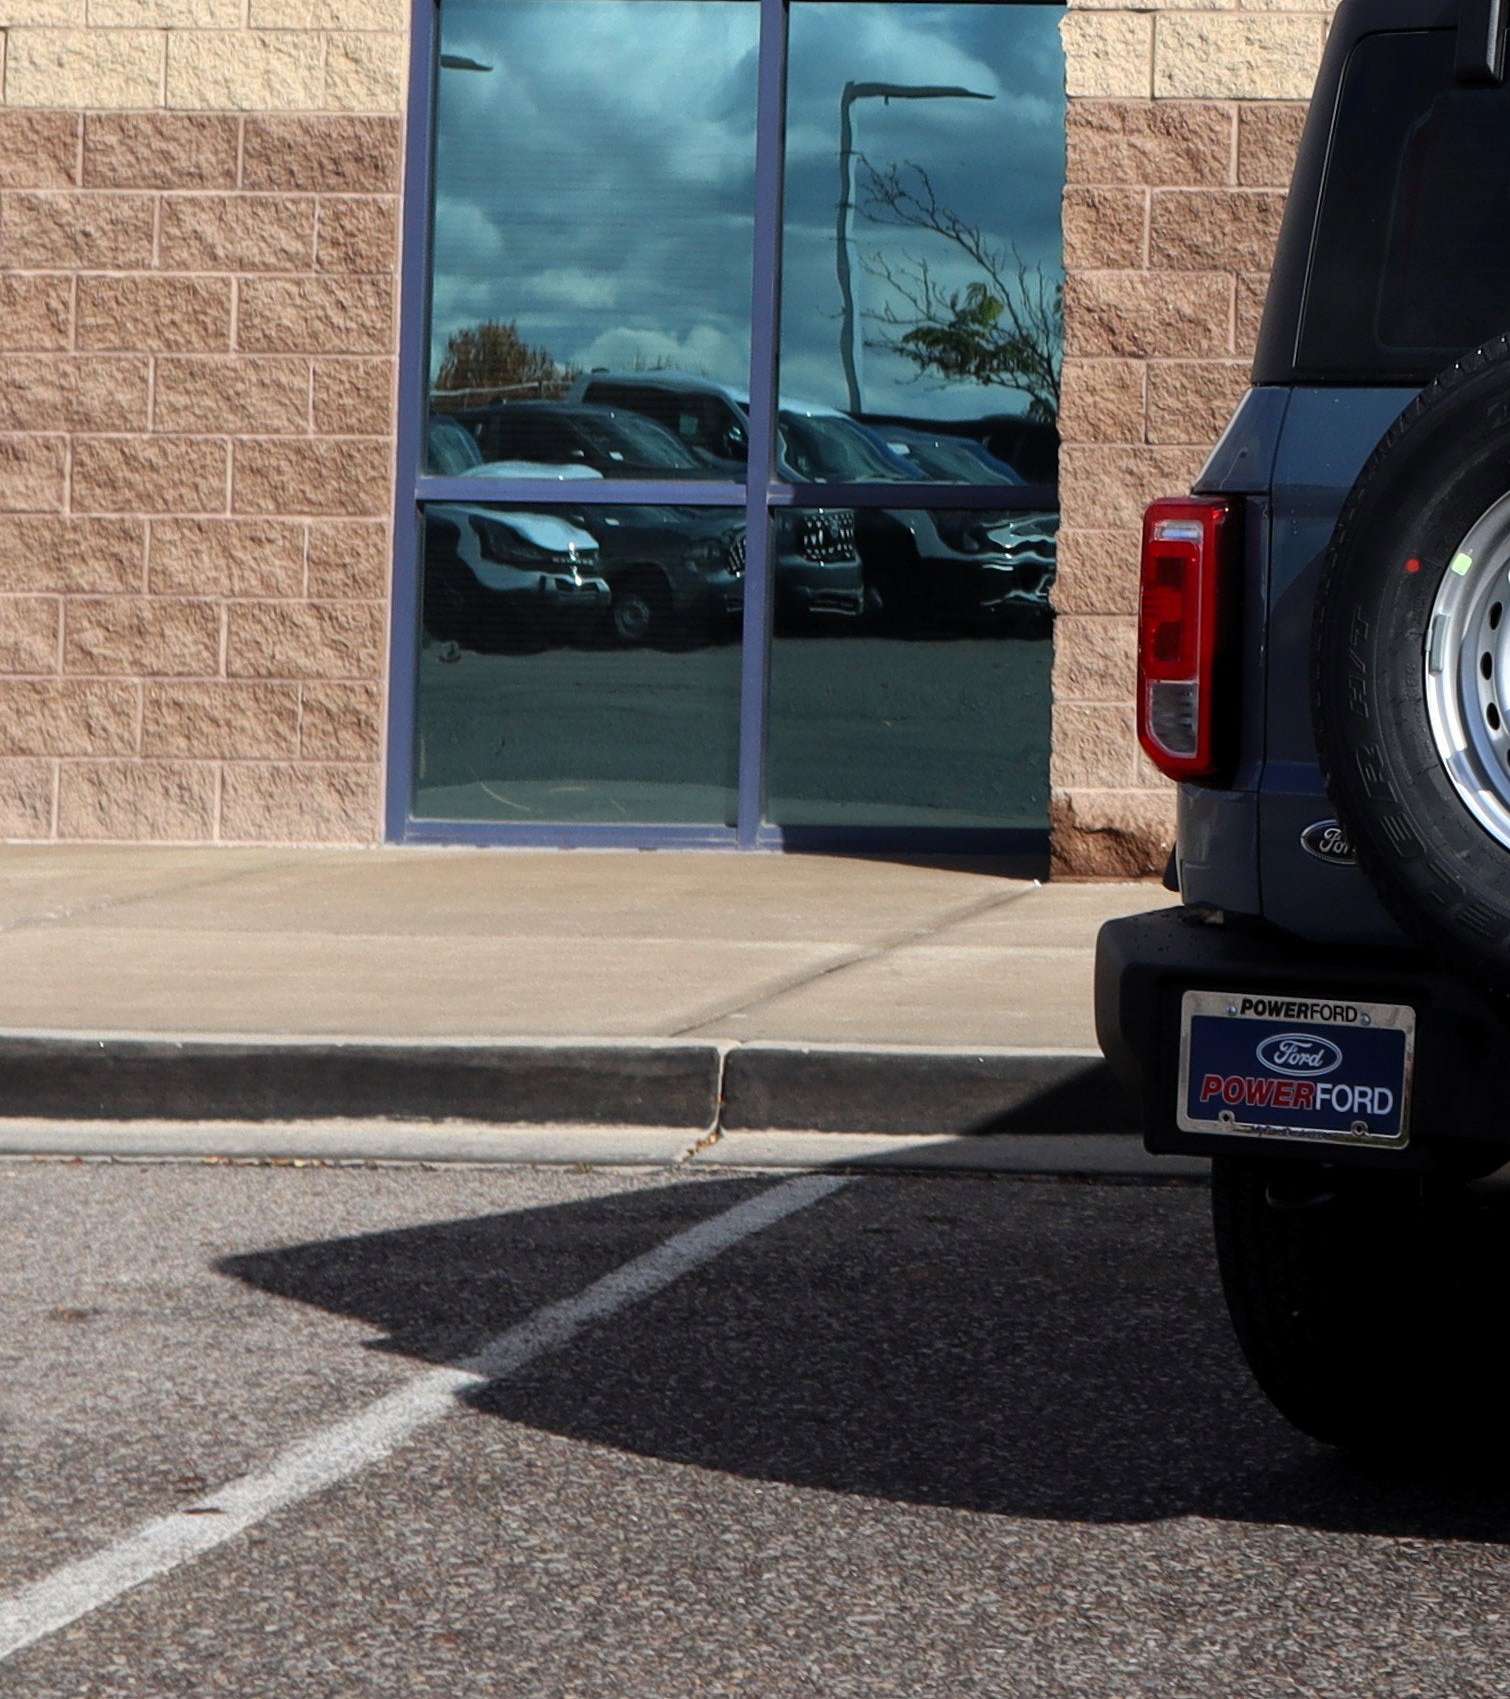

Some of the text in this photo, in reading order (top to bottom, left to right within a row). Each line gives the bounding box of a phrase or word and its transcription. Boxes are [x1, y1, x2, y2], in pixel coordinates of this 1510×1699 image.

[1319, 827, 1357, 855] For
[1240, 998, 1358, 1023] POWERFORD
[1273, 1040, 1324, 1067] Ford
[1200, 1074, 1394, 1115] POWERFORD
